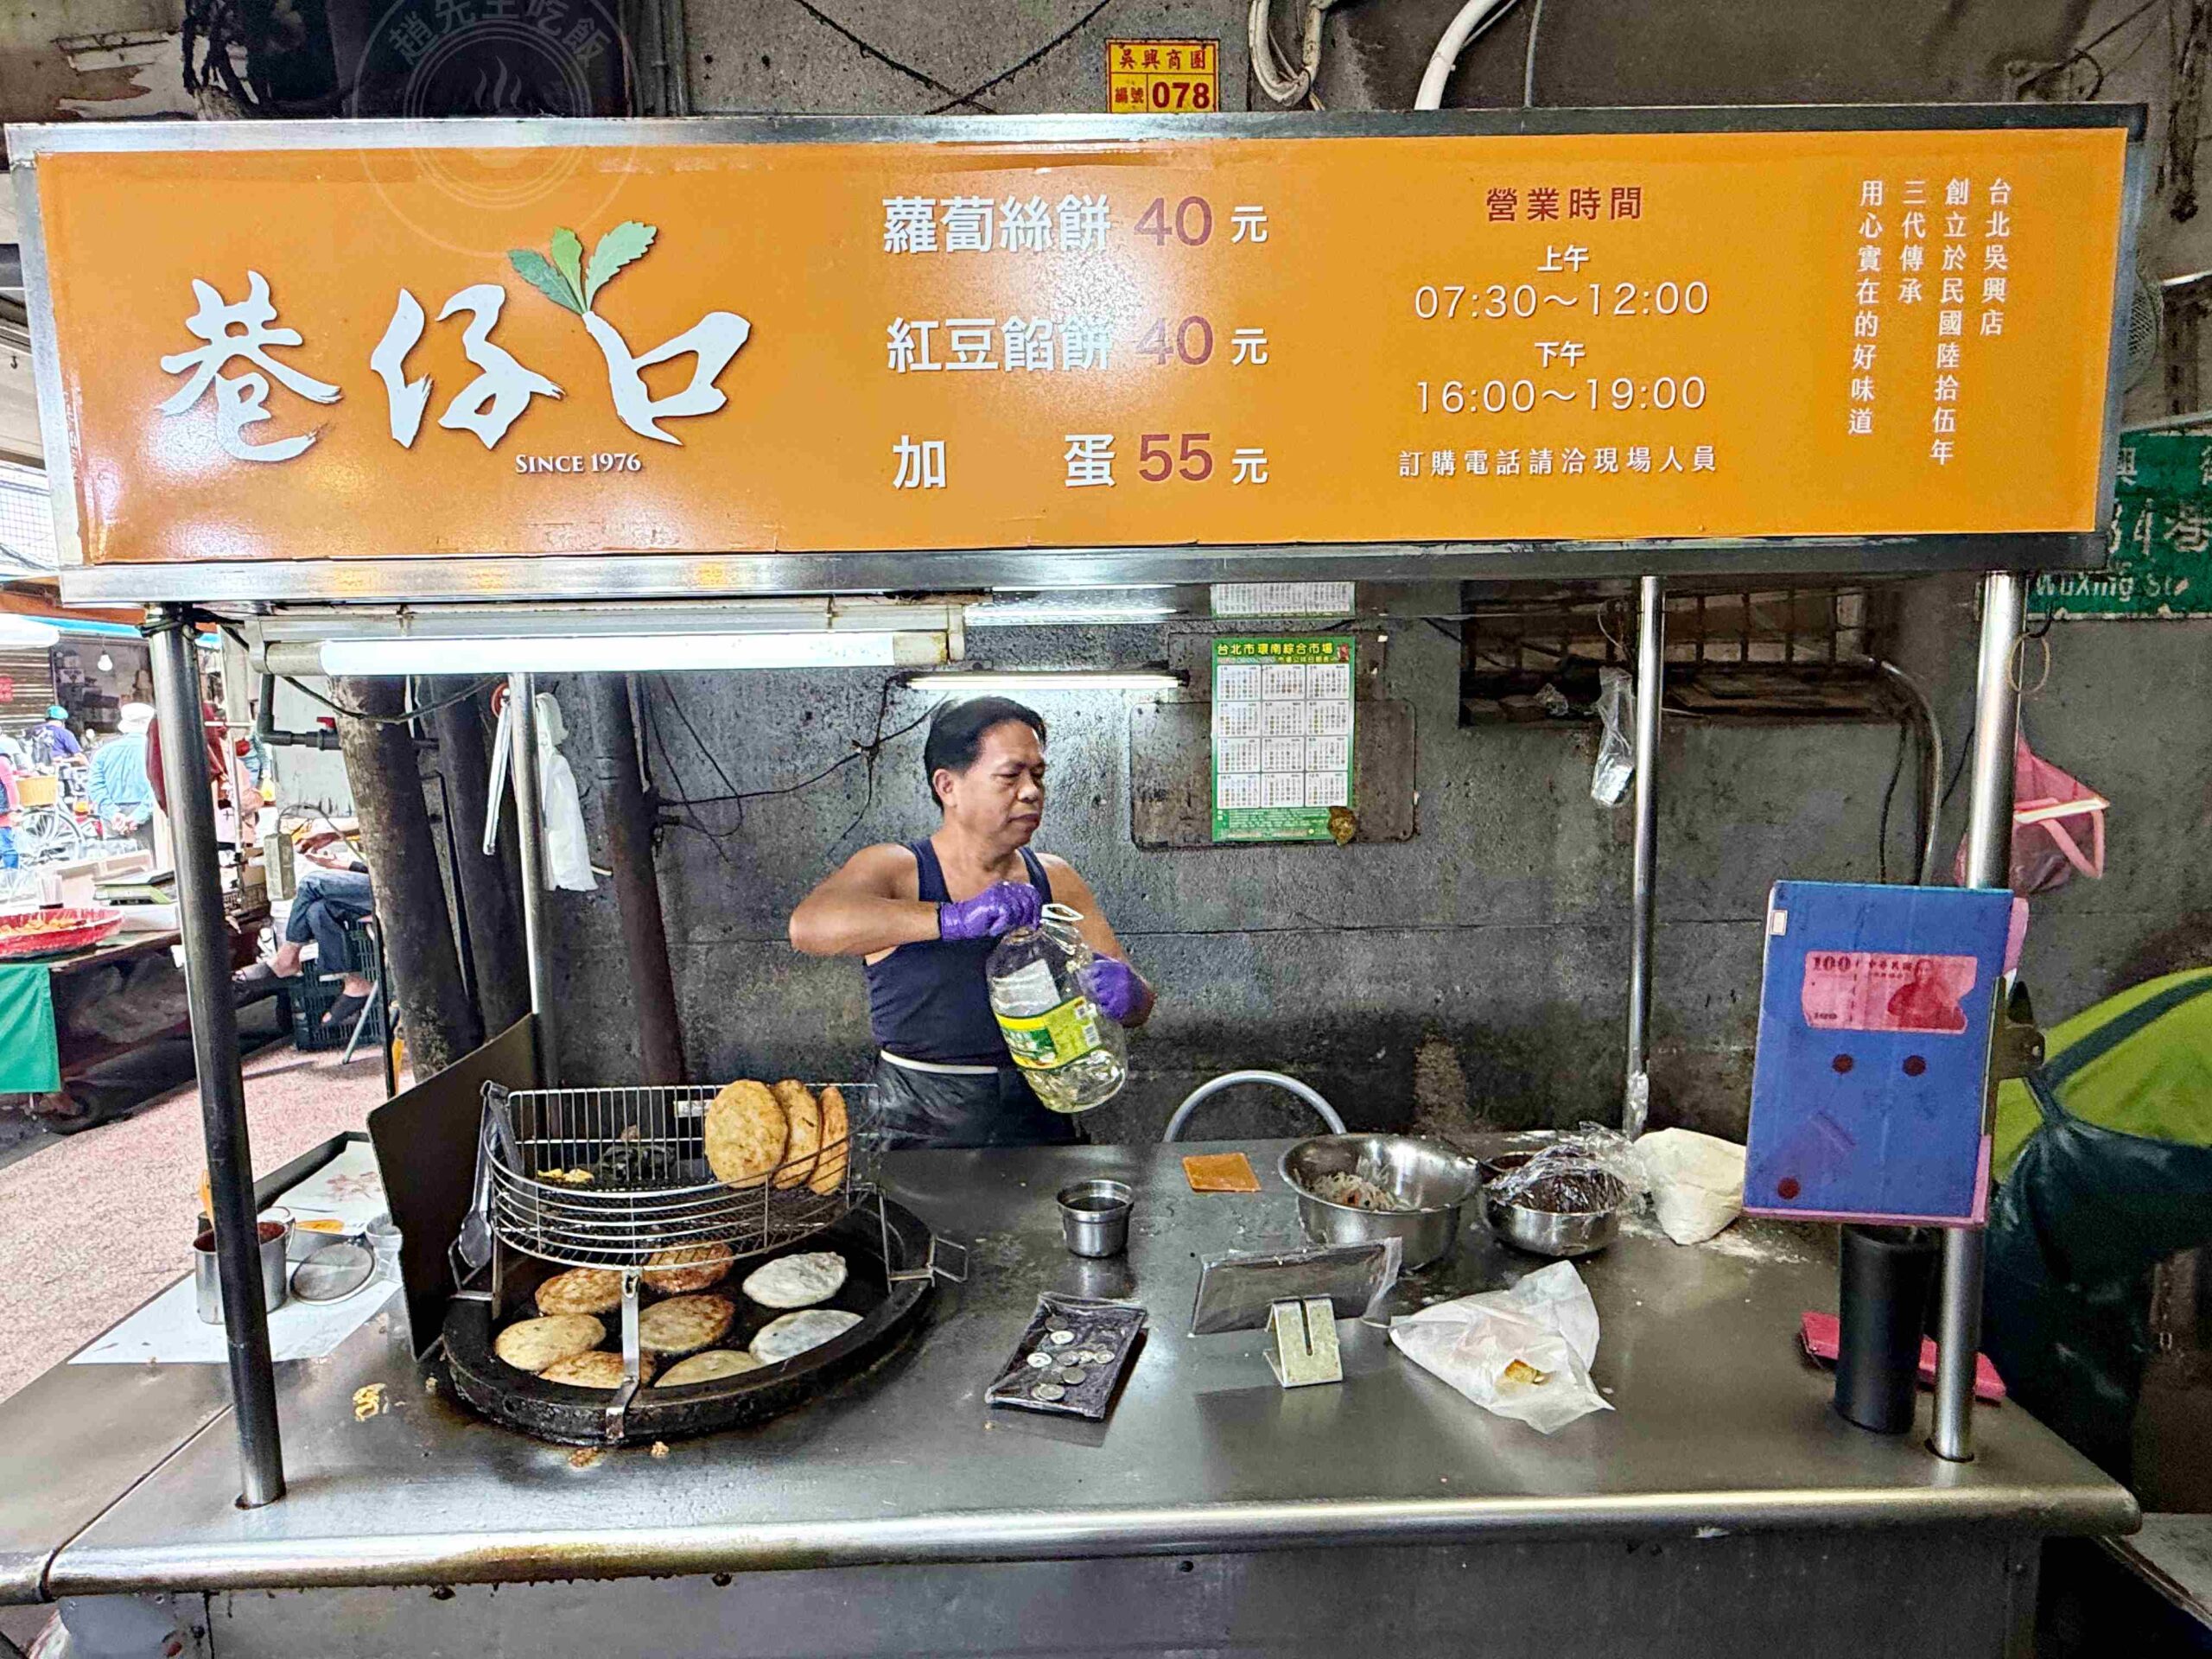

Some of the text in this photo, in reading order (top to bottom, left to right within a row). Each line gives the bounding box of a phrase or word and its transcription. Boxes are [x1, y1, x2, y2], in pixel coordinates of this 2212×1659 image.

[1119, 48, 1206, 70] 吳興商圈
[1115, 81, 1211, 109] 編號 078
[1485, 186, 1643, 222] 營業時間
[881, 194, 1269, 254] 蘿蔔絲餅 40 元
[1536, 244, 1590, 273] 上午
[1897, 180, 1928, 305] 三代傳承
[1979, 176, 2012, 337] 台北吳興店
[1847, 179, 1885, 435] 用心實在的好味道
[1929, 177, 1970, 466] 創立於民國陸拾伍年
[886, 315, 1269, 374] 紅豆餡餅 40 元
[1534, 340, 1586, 369] 下午
[155, 270, 751, 461] 巷仔口
[589, 452, 642, 473] 1976
[1138, 432, 1214, 483] 55
[1231, 448, 1269, 485] 元
[1398, 444, 1717, 478] 訂購電話請洽現場人員
[1217, 642, 1333, 656] 台北市環南綜合市場
[1813, 955, 1853, 973] 100
